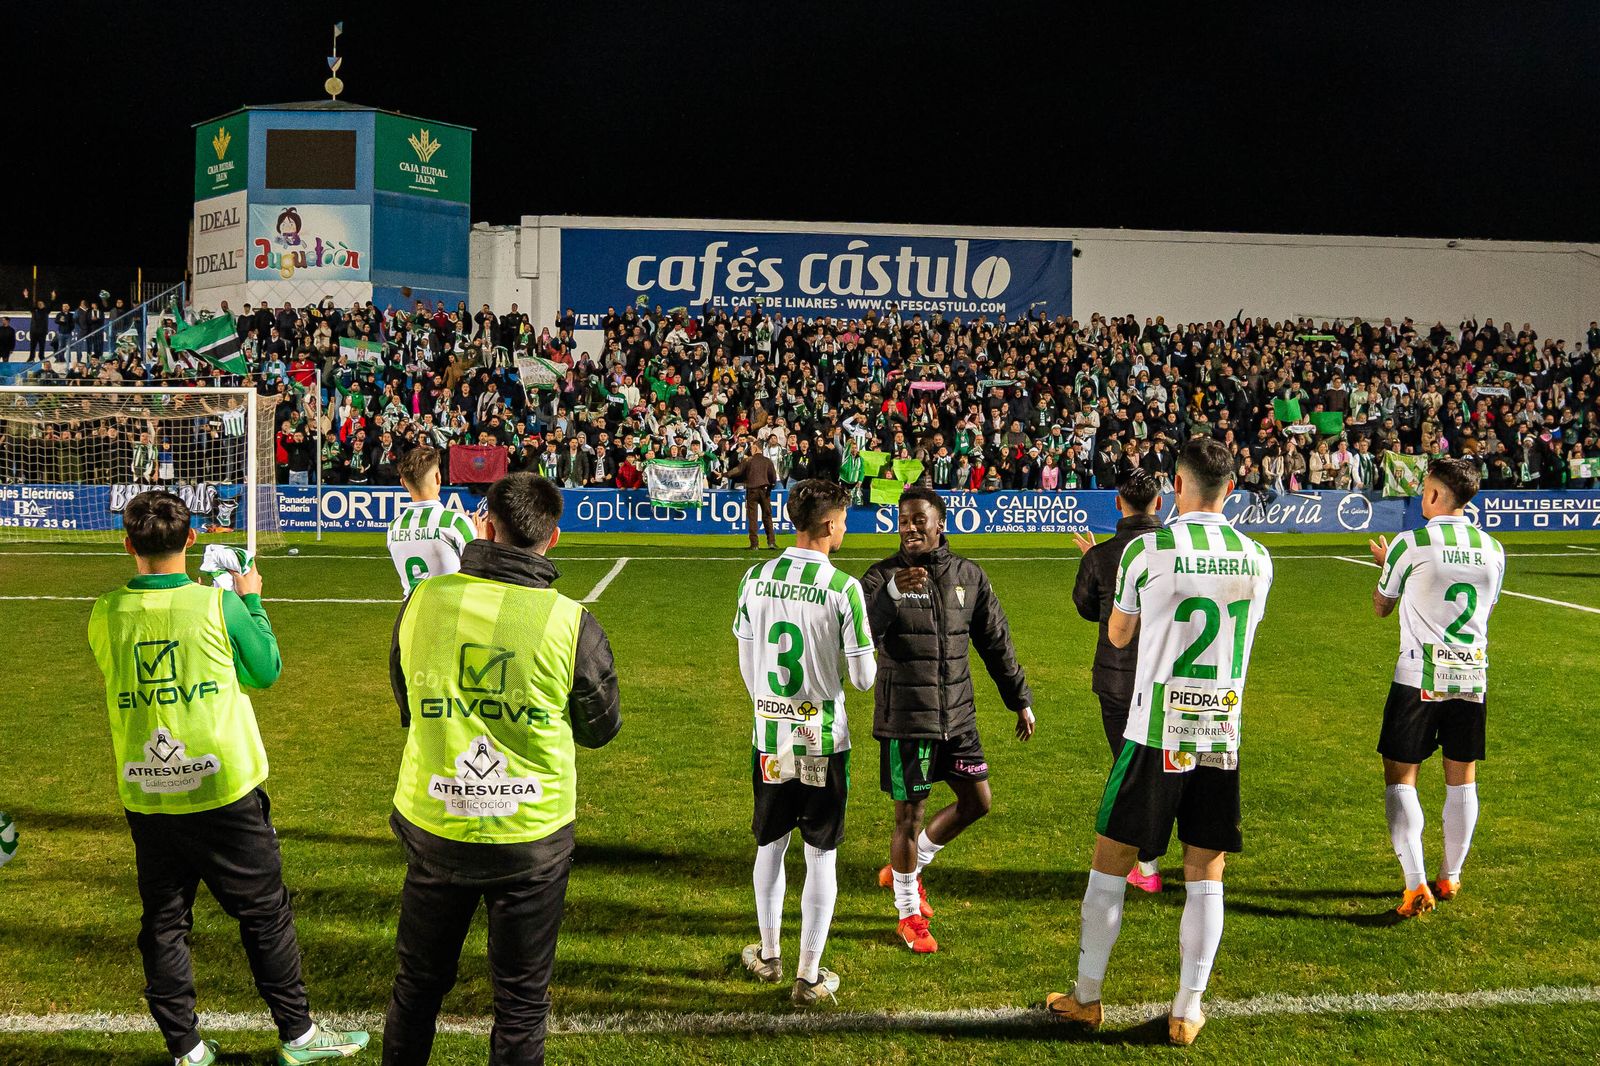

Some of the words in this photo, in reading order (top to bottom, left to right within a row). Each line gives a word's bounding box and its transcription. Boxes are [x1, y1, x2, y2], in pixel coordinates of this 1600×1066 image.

[421, 165, 448, 179] RURAL
[200, 207, 240, 232] IDEAL
[196, 251, 237, 275] IDEAL
[626, 240, 784, 305] cafés
[713, 295, 728, 306] EL
[766, 297, 782, 308] DE
[785, 297, 838, 309] LINARES
[847, 299, 1006, 313] WWW.CAFESCASTULO.COM
[21, 487, 75, 500] Eléctricos
[321, 490, 465, 520] ORTEA
[996, 495, 1078, 510] CALIDAD
[23, 518, 39, 528] 67
[43, 519, 59, 528] 33
[61, 519, 77, 529] 61
[290, 520, 317, 528] Fuente
[344, 520, 350, 528] 6
[356, 520, 366, 528] C/
[985, 509, 998, 524] Y
[1003, 509, 1088, 524] SERVICIO
[414, 528, 441, 541] SALA
[984, 525, 995, 533] C/
[995, 523, 1026, 533] BAÑOS,
[1041, 525, 1055, 533] 653
[1056, 525, 1066, 533] 78
[1174, 554, 1260, 576] ALBARRÁN
[1443, 548, 1470, 565] IVÁN
[755, 582, 828, 606] CALDERÓN
[1444, 582, 1478, 644] 2
[1172, 596, 1252, 680] 21
[767, 621, 805, 697] 3
[117, 680, 219, 709] GIVOVA
[420, 697, 551, 726] GIVOVA
[1168, 725, 1189, 734] DOS
[1192, 727, 1227, 736] TORRES
[128, 760, 215, 777] ATRESVEGA
[433, 782, 536, 796] ATRESVEGA
[451, 798, 512, 810] Edificación
